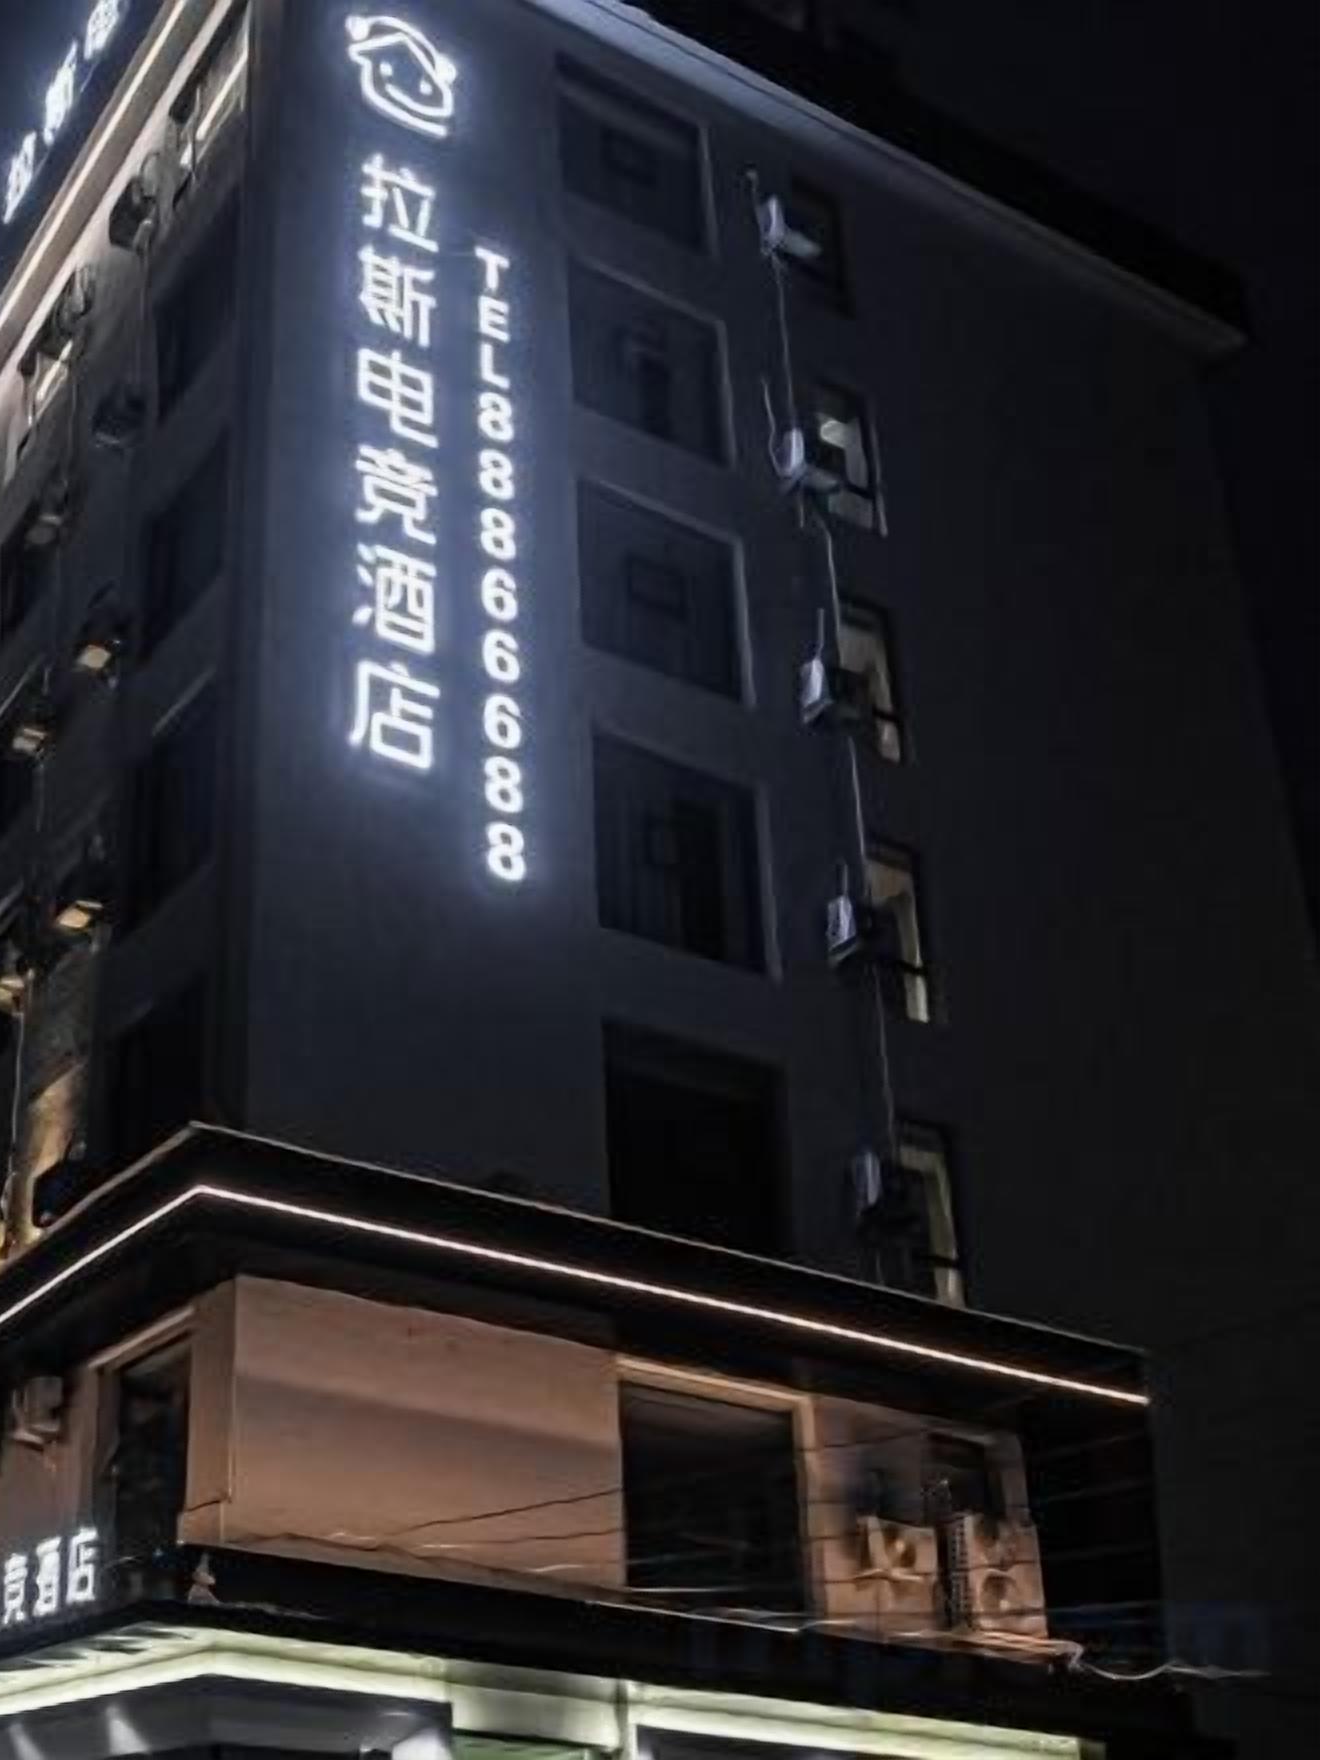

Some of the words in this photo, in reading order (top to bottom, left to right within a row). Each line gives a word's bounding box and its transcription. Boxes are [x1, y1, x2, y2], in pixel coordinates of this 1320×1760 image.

[349, 153, 441, 771] 拉斯电竞酒店
